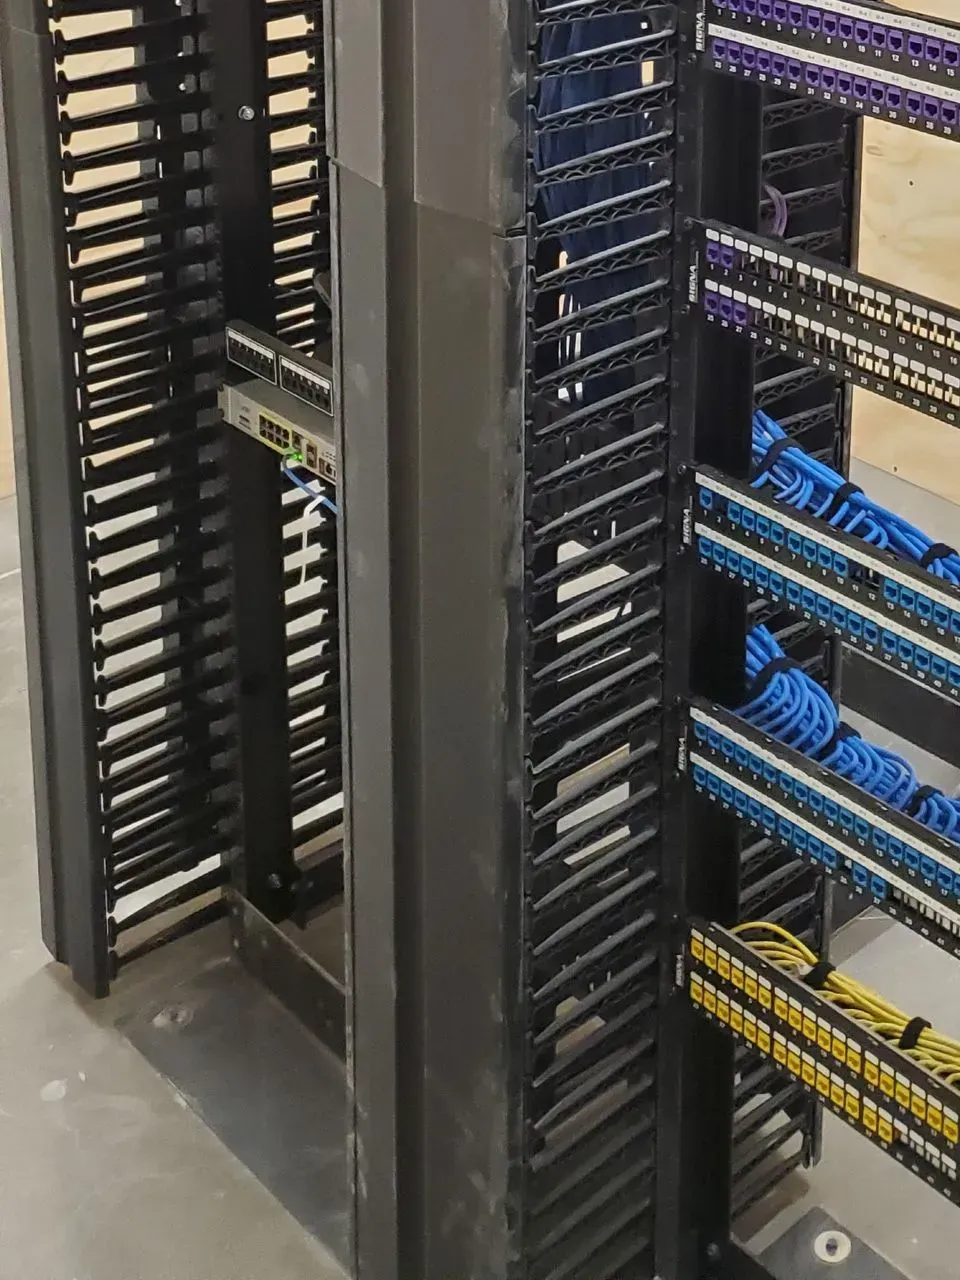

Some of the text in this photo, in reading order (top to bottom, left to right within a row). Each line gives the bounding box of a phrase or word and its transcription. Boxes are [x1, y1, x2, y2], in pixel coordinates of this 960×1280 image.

[695, 12, 704, 51] SIGNA
[688, 265, 696, 302] SIGNA
[683, 508, 691, 544] SIGNA
